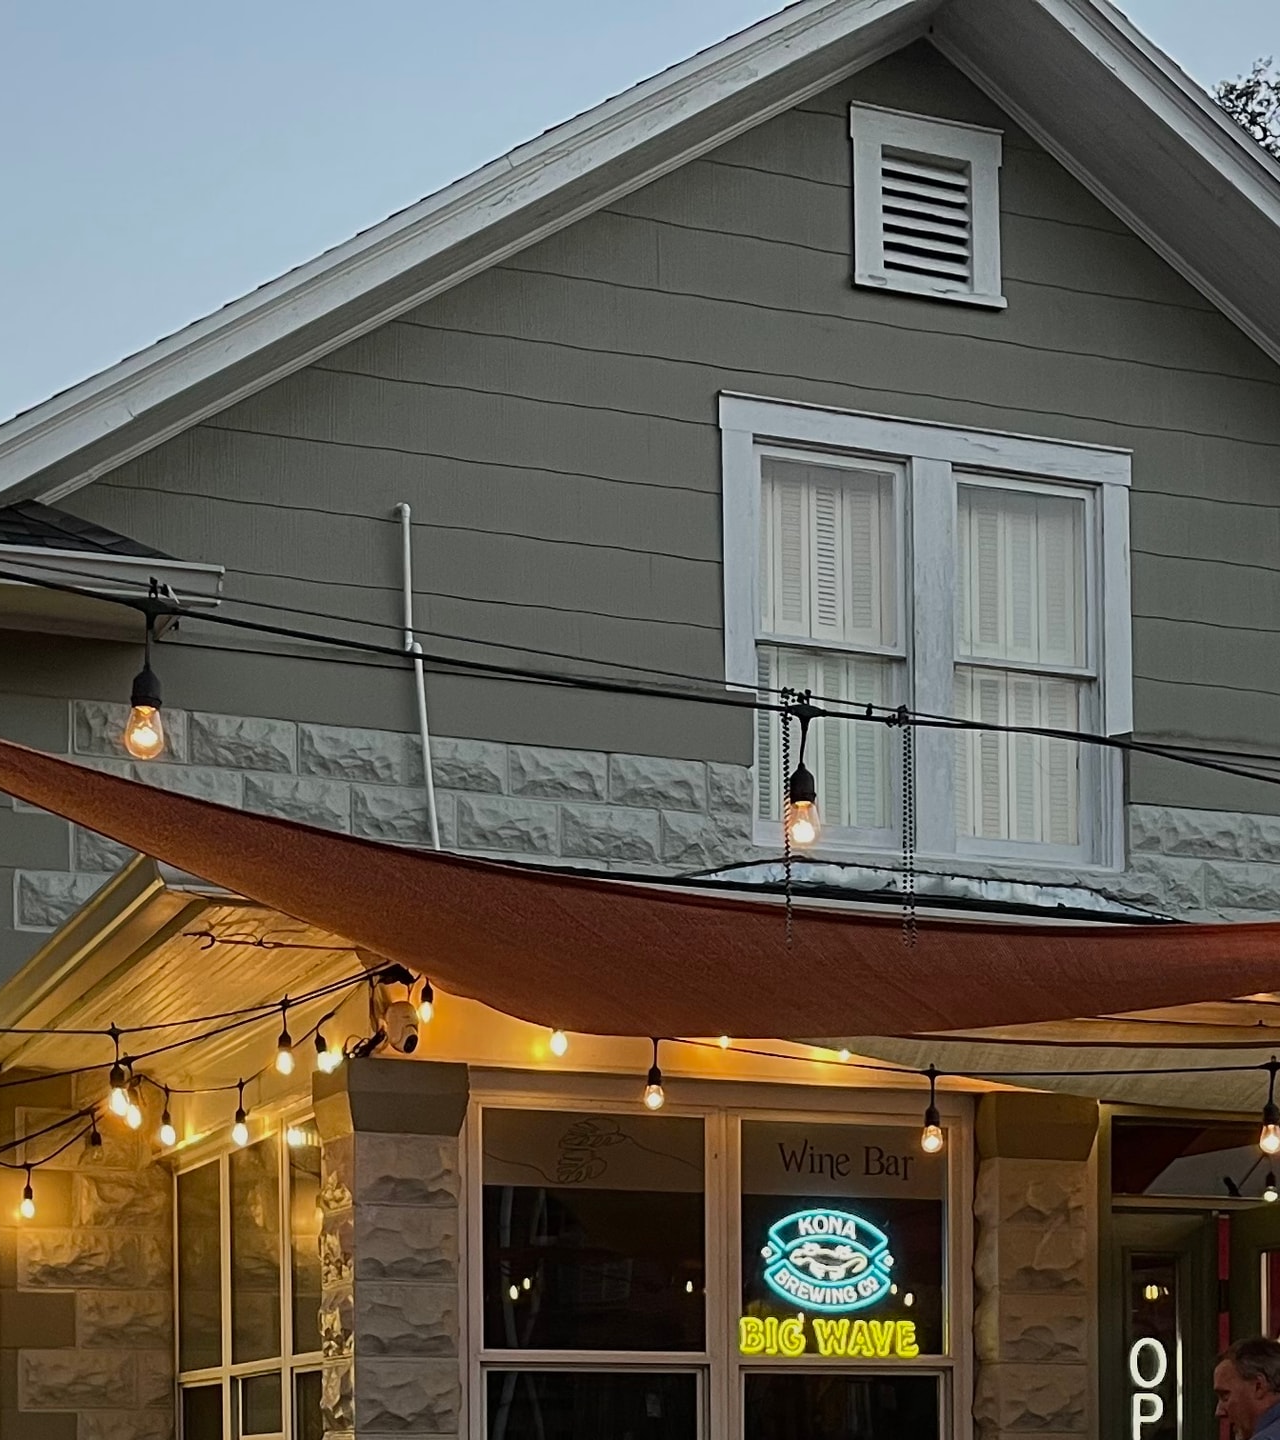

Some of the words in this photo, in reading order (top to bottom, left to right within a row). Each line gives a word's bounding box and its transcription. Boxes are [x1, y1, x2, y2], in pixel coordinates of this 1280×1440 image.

[777, 1138, 850, 1181] Wine
[863, 1146, 914, 1181] Bar
[797, 1214, 857, 1241] KONA
[773, 1270, 858, 1304] BREWING
[739, 1316, 807, 1357] BIG
[812, 1318, 919, 1358] WAVE
